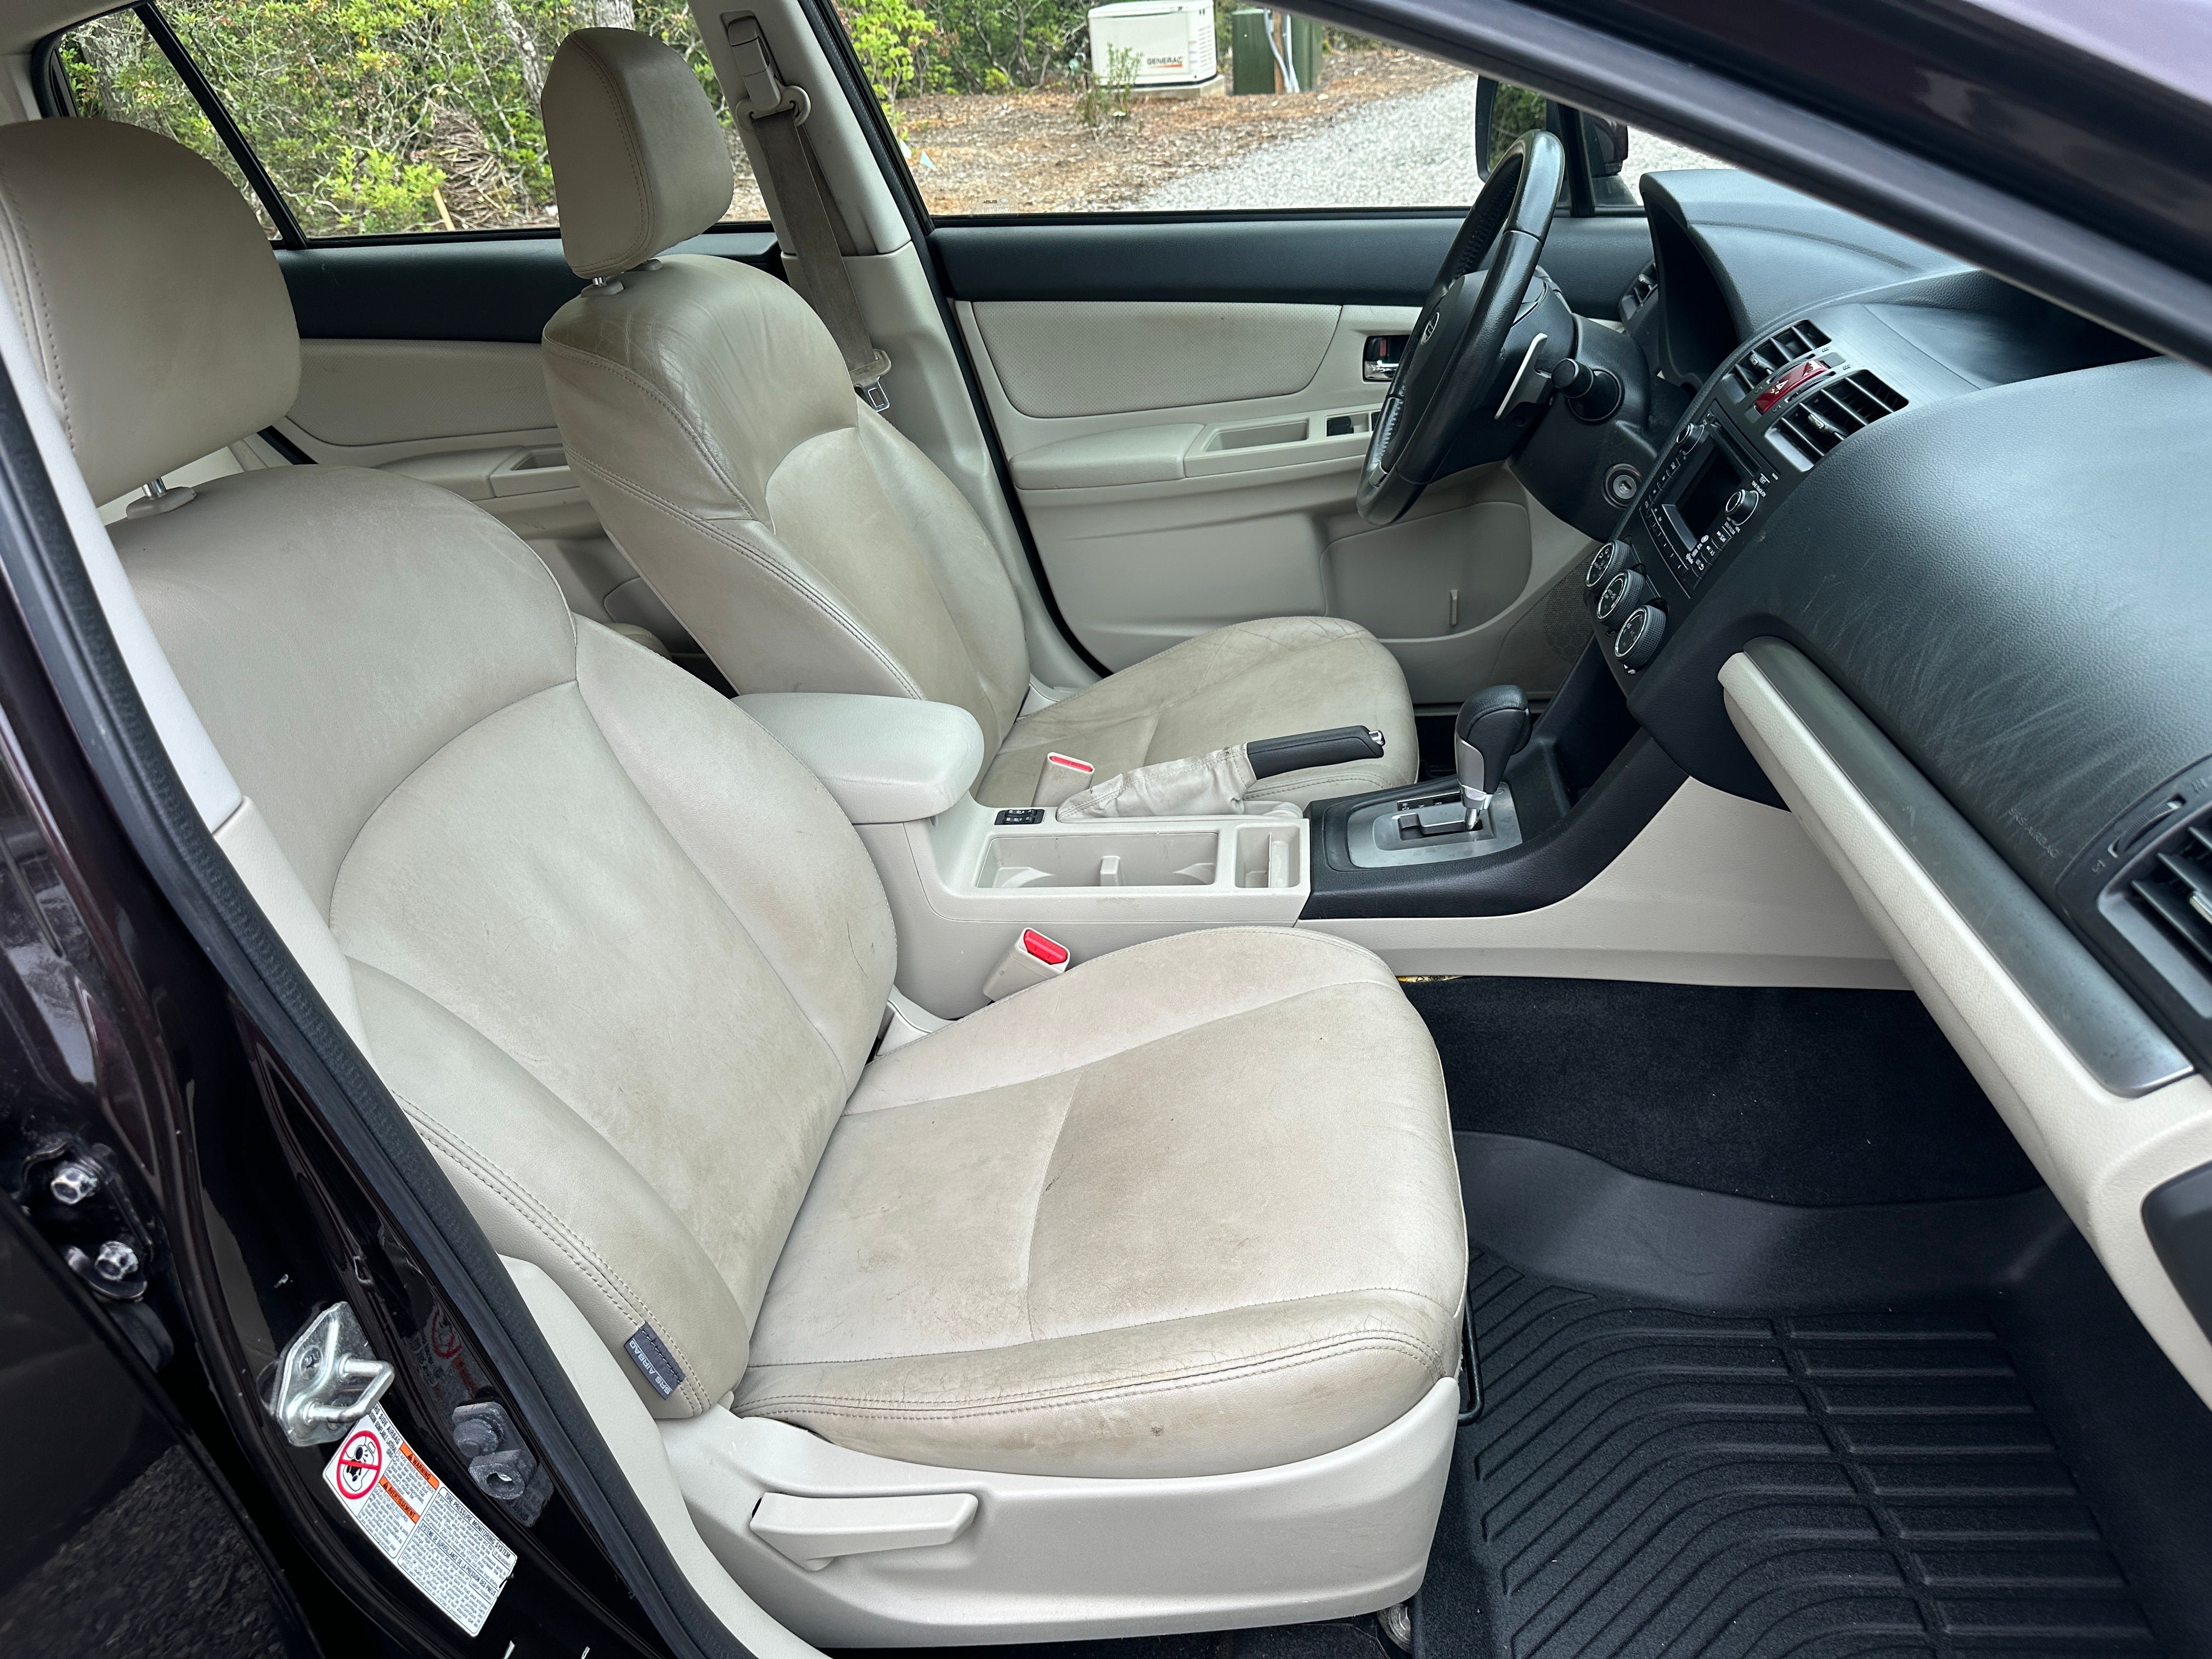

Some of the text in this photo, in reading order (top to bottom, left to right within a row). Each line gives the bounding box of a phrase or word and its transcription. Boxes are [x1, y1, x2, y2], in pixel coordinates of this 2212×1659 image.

[1147, 57, 1183, 65] GENERAC
[629, 1340, 671, 1395] SRS AIRBAG
[379, 1413, 388, 1427] SIDE
[386, 1426, 400, 1445] AIRBAG
[413, 1458, 432, 1481] WARNING
[388, 1487, 416, 1519] AVERTISSEMENT
[445, 1492, 511, 1559] TIRE PRESSURE MONITORING SYSTEM
[466, 1566, 481, 1582] PRESSION
[479, 1578, 487, 1588] DES
[486, 1584, 496, 1596] PNEUS
